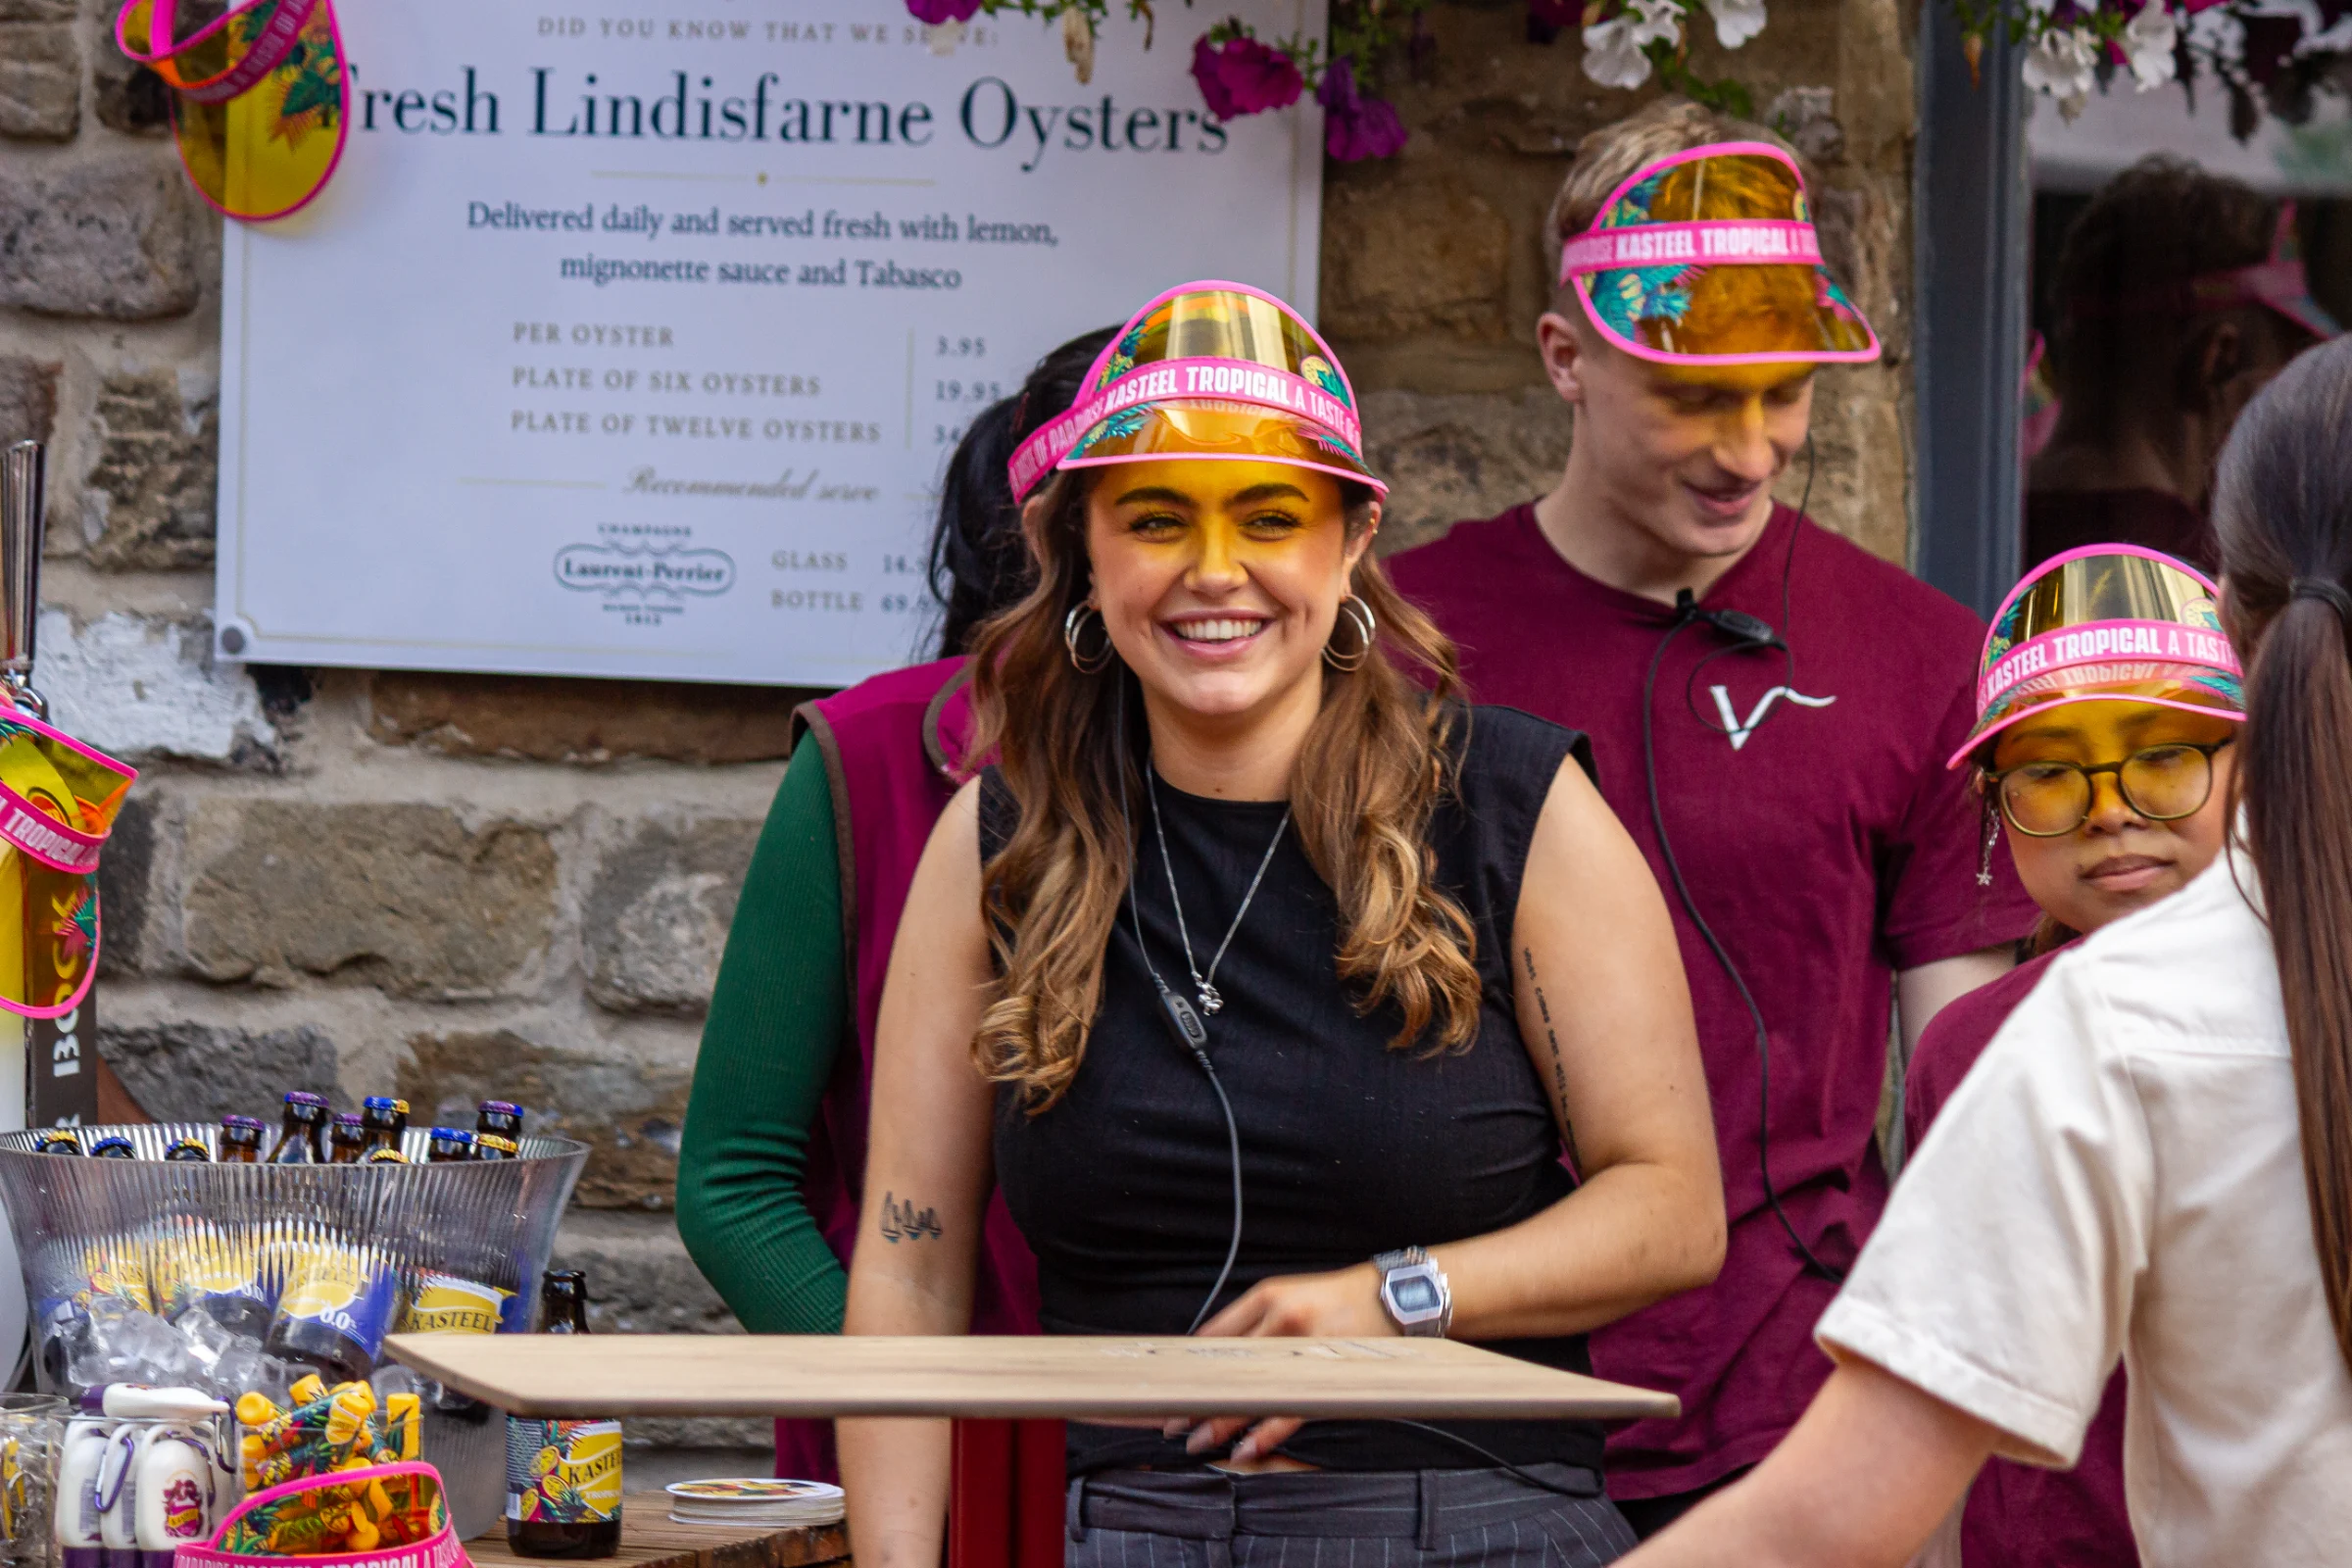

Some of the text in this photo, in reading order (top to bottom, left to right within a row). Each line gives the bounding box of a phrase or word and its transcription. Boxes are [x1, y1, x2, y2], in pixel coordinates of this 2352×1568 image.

[538, 17, 999, 47] DID YOU KNOW THAT WE SEVE:
[528, 66, 934, 147] Lindisfarne
[960, 75, 1229, 172] Oysters
[467, 201, 1058, 247] Delivered daily and served fresh with lemon,
[1616, 230, 1696, 262] KASTEEL
[1700, 226, 1789, 257] TROPICAL
[561, 254, 962, 289] mignonette sauce and Tabasco
[514, 322, 673, 347] PER OYSTER
[513, 367, 820, 396] PLATE OF SIX OYSTERS
[1103, 368, 1179, 414] KASTEEL
[1186, 365, 1291, 407] TROPICAL
[1295, 385, 1306, 411] A
[1308, 390, 1346, 434] TASTE
[512, 411, 881, 444] PLATE OF TWELVE OYSTERS
[771, 551, 848, 572] GLASS
[771, 590, 863, 612] BOTTLE
[1986, 642, 2049, 703] KASTEEL
[2052, 626, 2163, 662] TROPICAL
[2167, 629, 2181, 656] A
[4, 807, 86, 866] TROPICAL
[412, 1311, 495, 1333] KASTEEL
